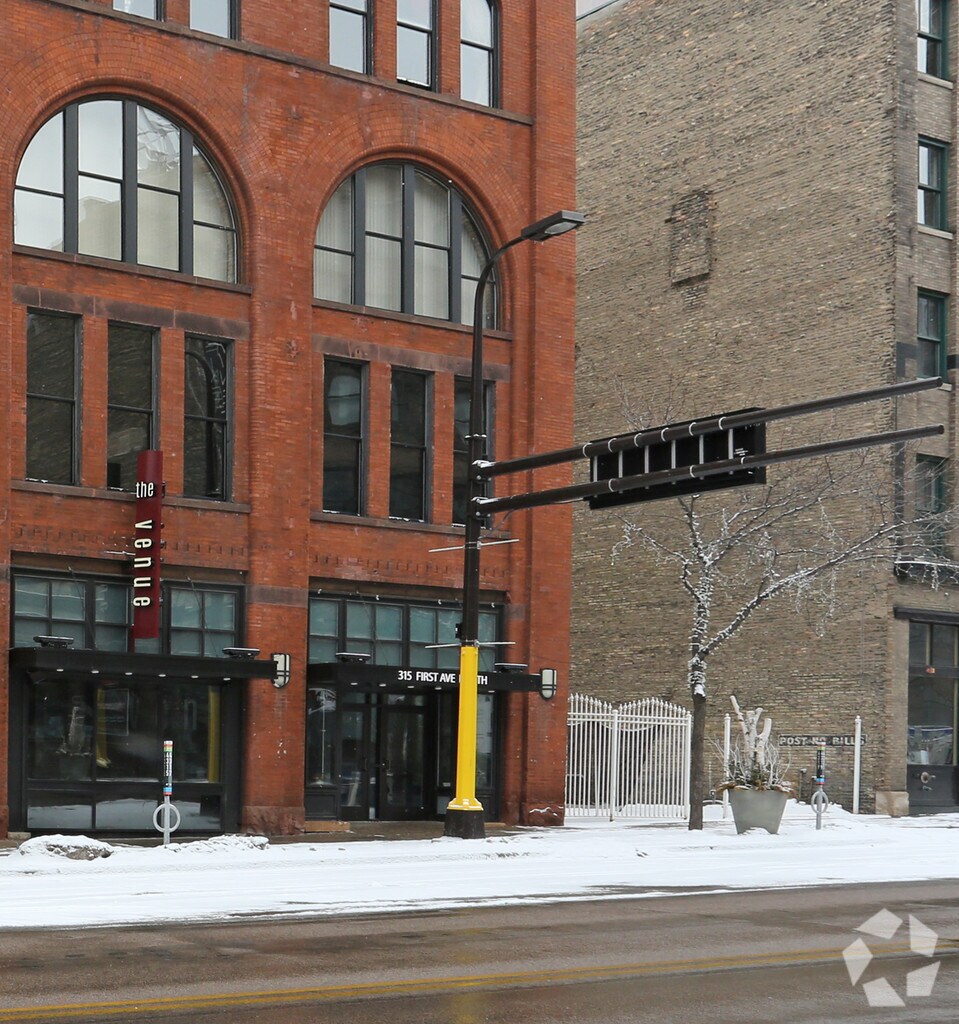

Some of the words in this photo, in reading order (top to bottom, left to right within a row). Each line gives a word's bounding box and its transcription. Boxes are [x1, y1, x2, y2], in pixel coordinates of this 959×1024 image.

[136, 481, 154, 498] the
[133, 520, 153, 607] venue
[398, 670, 412, 681] 315
[416, 671, 439, 682] FIRST
[440, 673, 456, 684] AVE
[780, 736, 808, 746] POST
